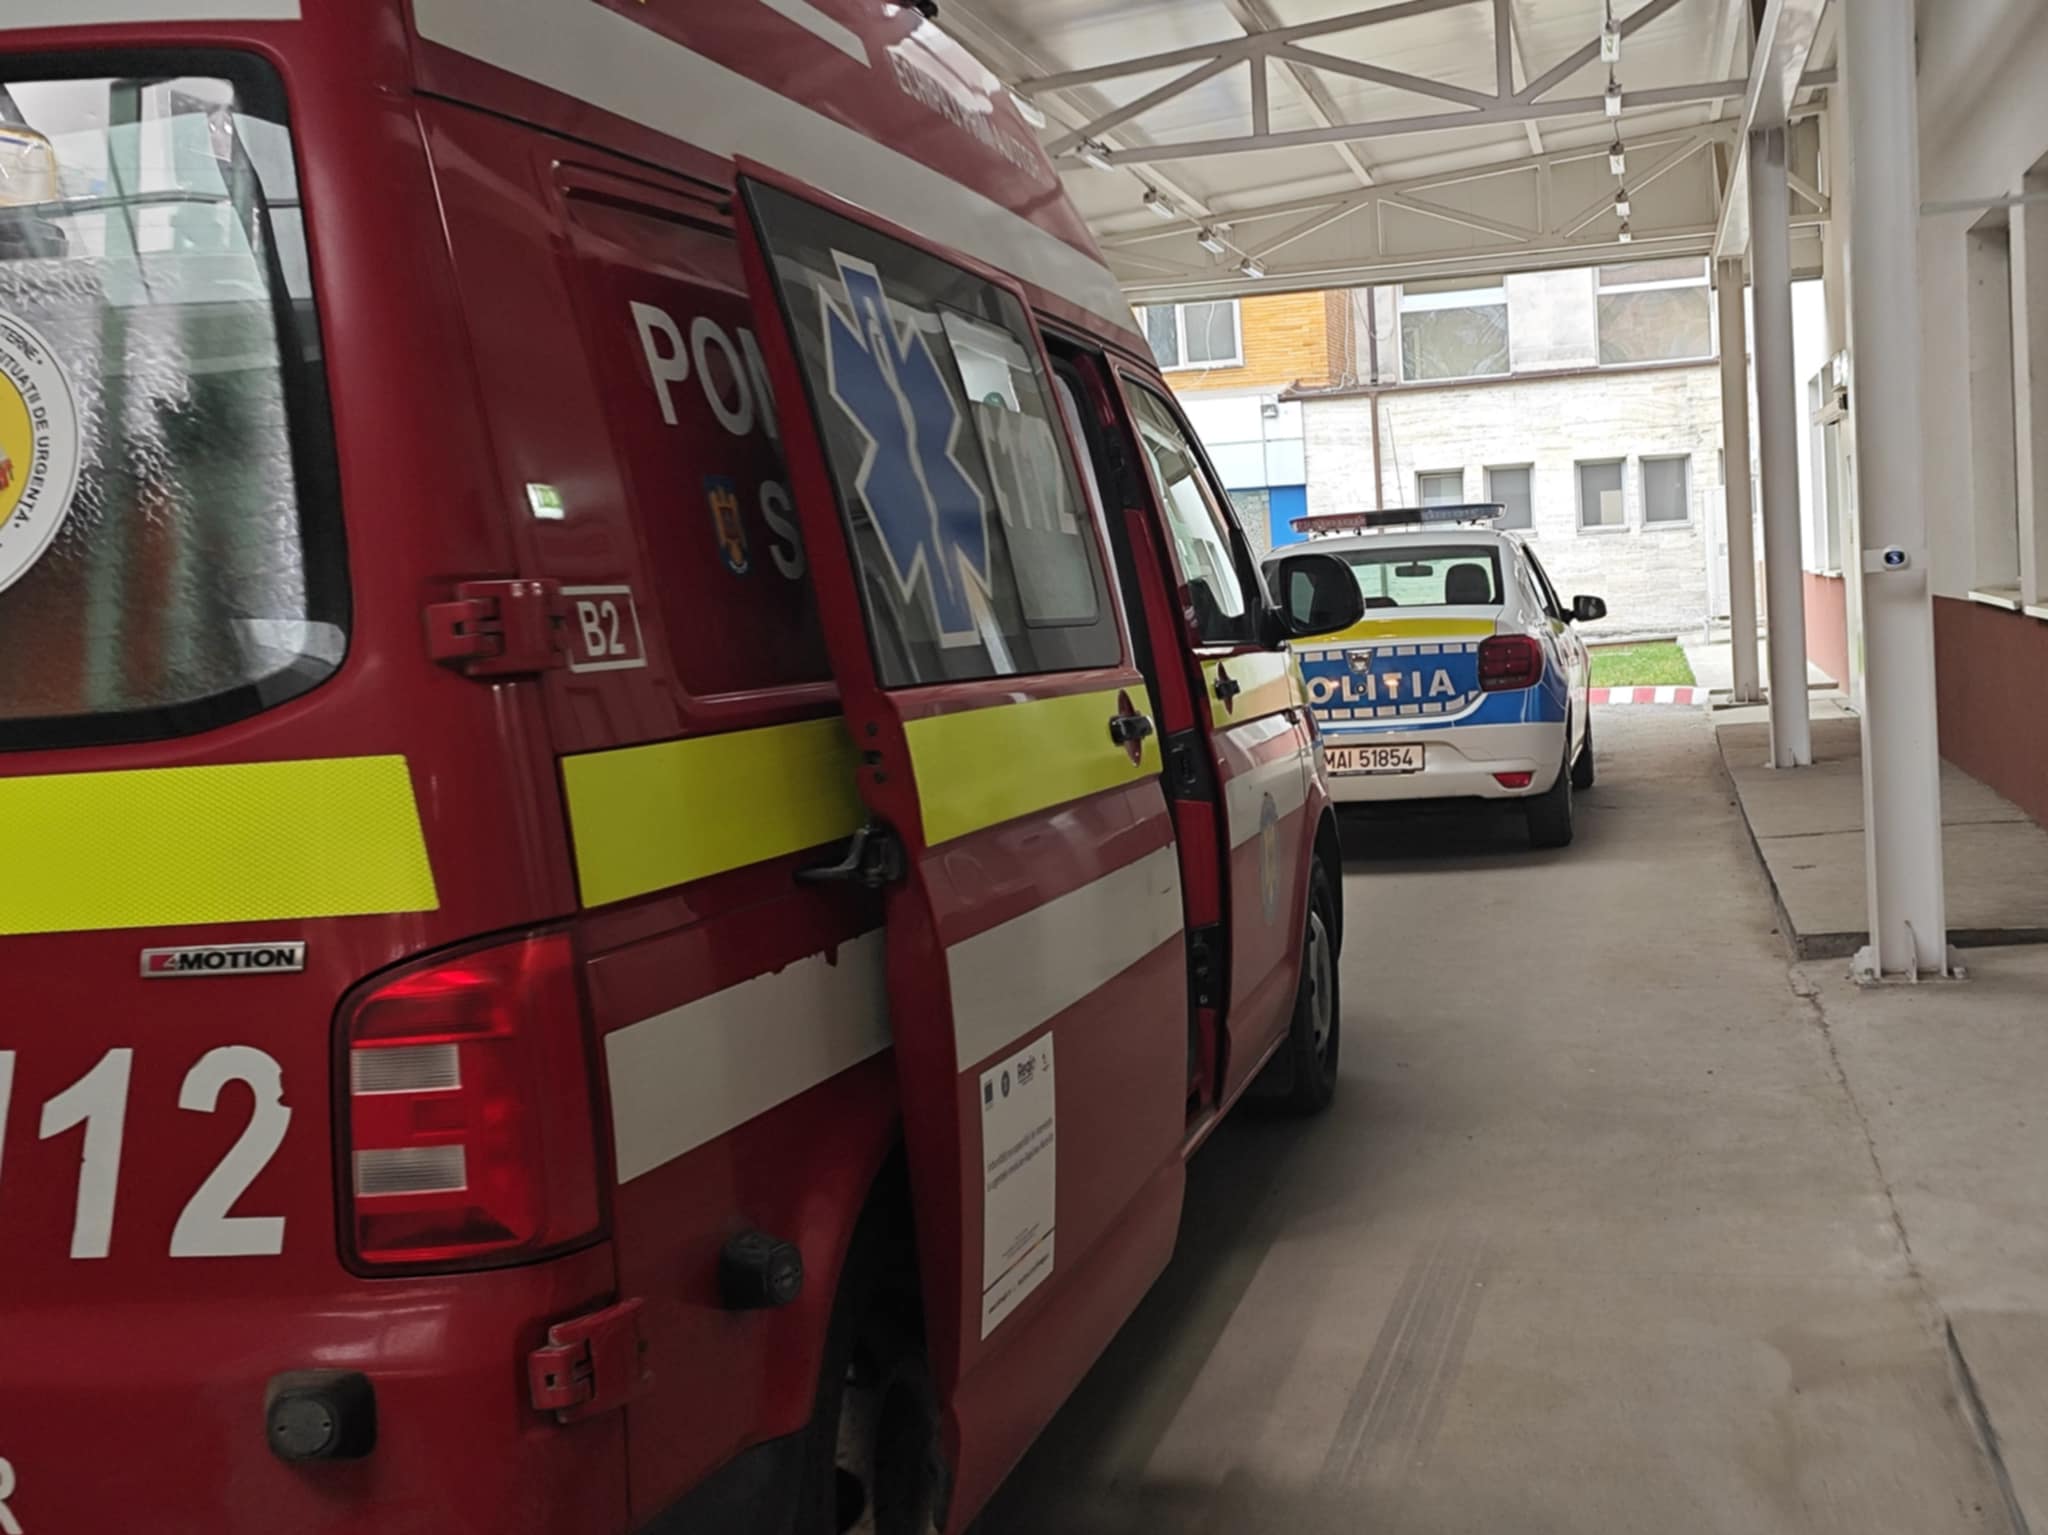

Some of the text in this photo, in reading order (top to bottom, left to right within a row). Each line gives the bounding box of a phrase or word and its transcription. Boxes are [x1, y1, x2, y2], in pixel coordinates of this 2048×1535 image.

[0, 323, 39, 361] TERNE
[32, 406, 49, 431] DE
[577, 600, 626, 657] B2
[1306, 668, 1456, 704] OLITIA
[1324, 747, 1414, 770] MAI 51854
[162, 949, 296, 971] 4MOTION
